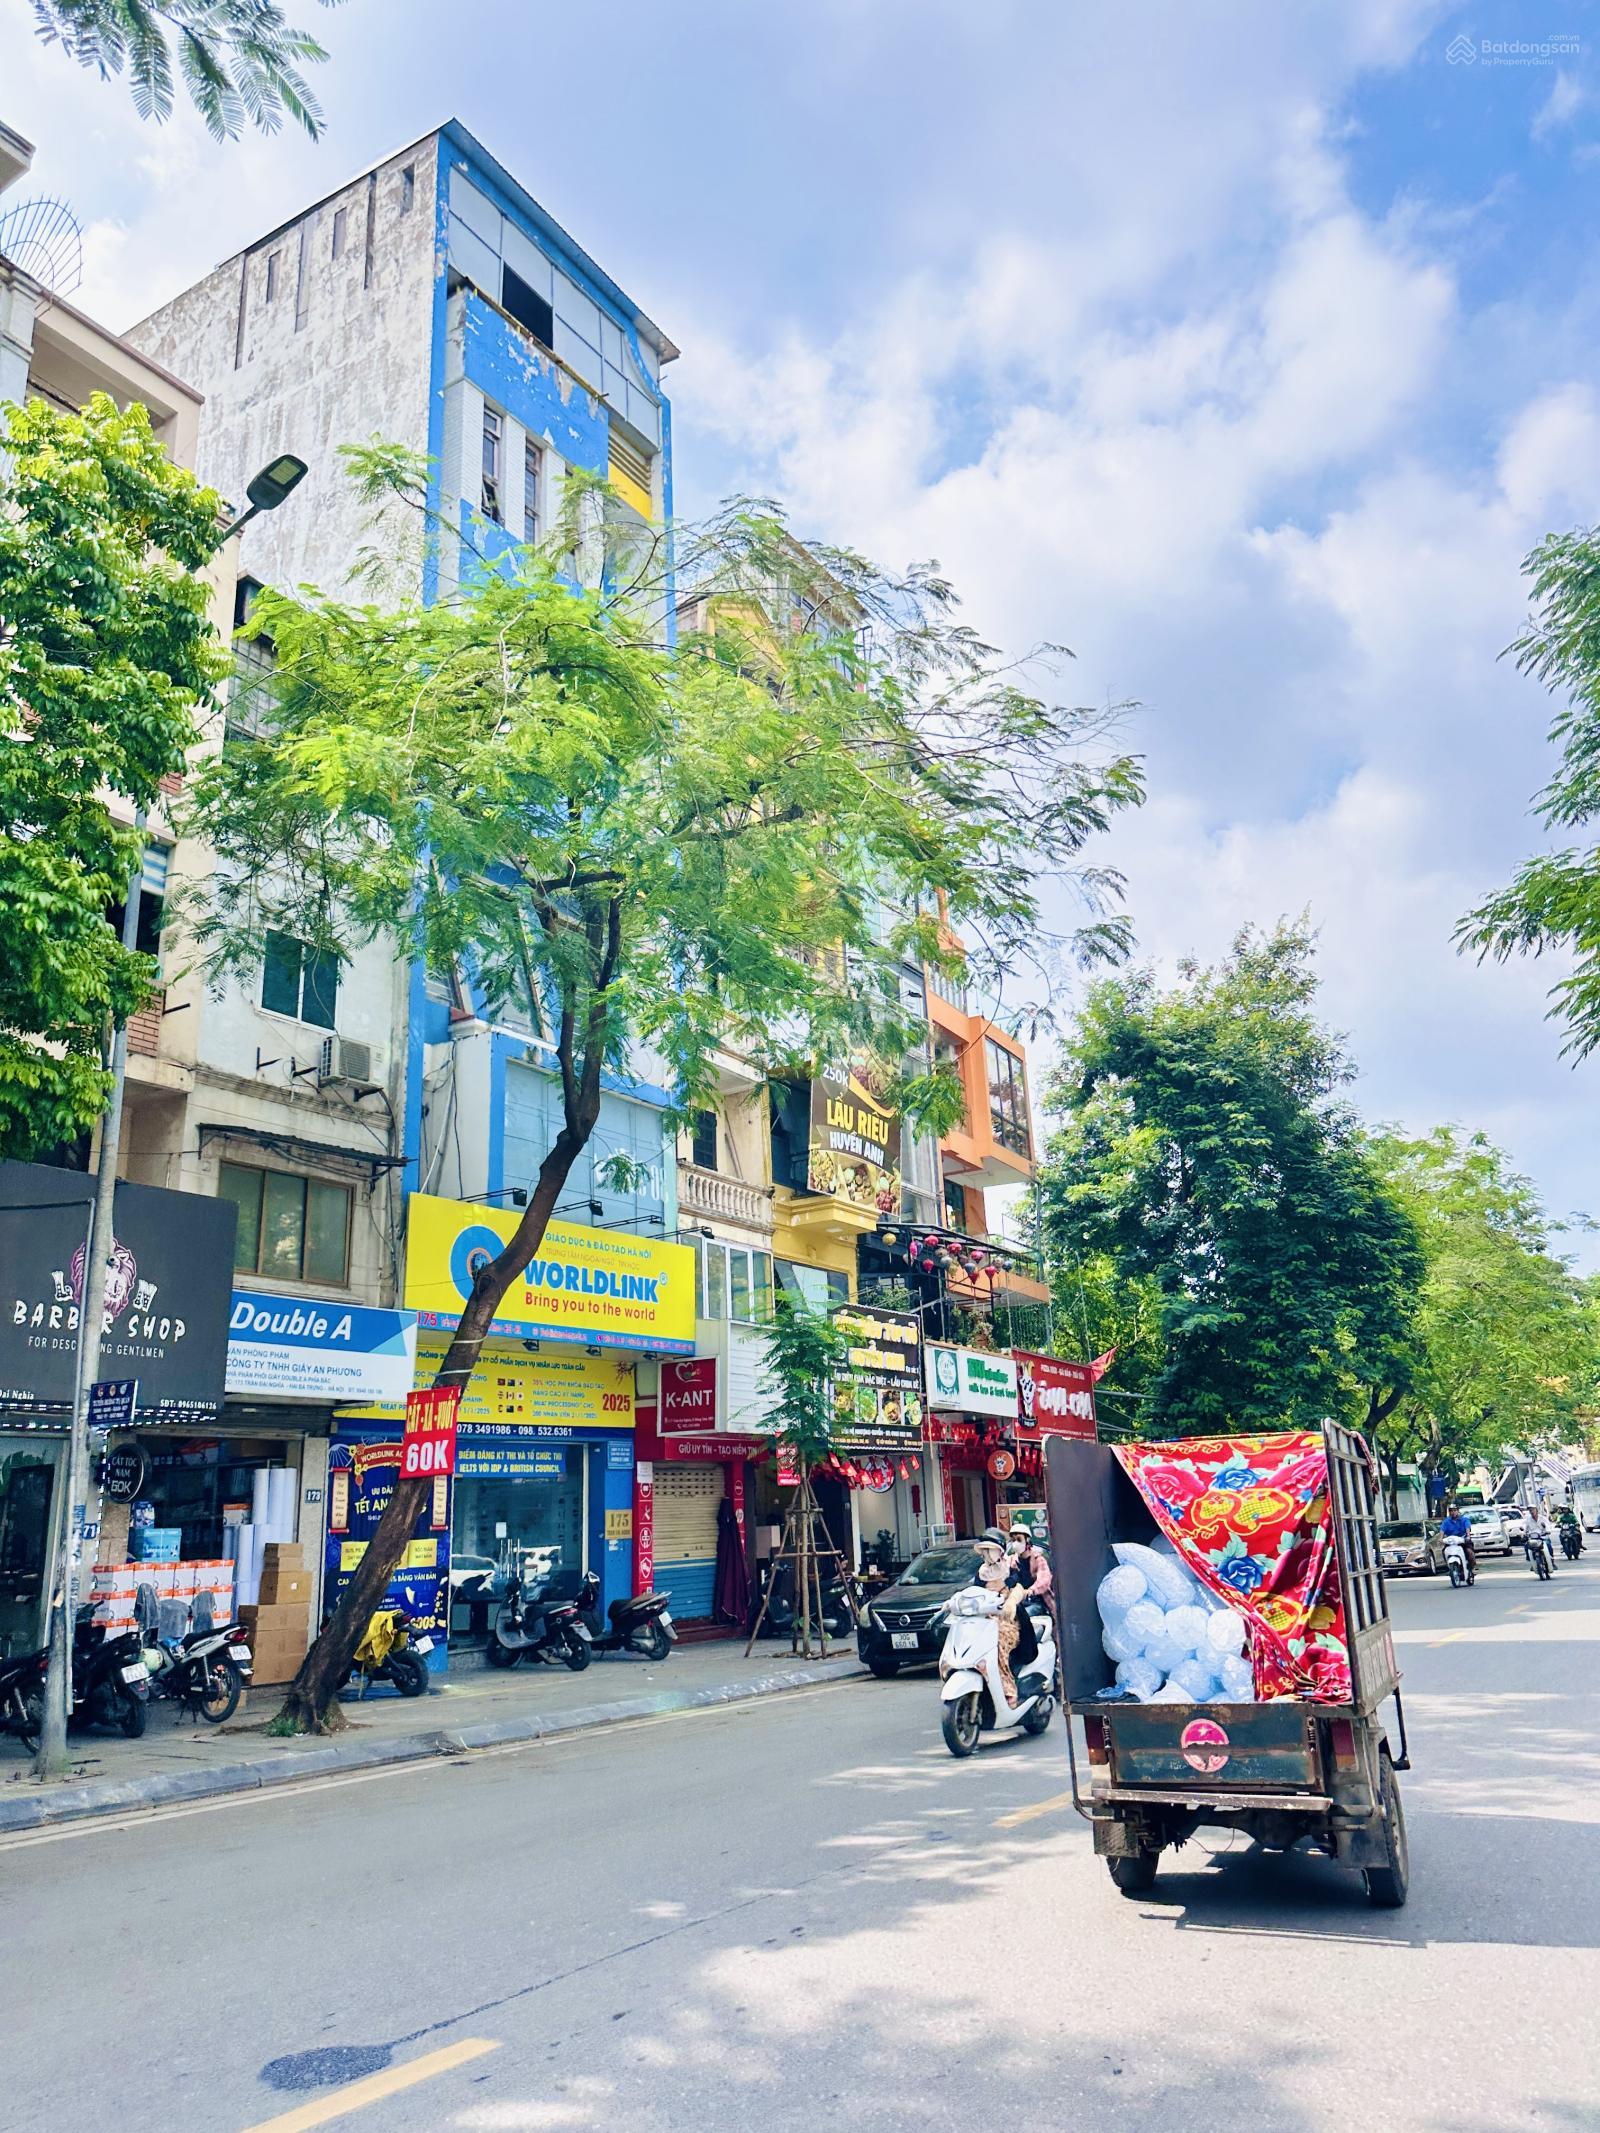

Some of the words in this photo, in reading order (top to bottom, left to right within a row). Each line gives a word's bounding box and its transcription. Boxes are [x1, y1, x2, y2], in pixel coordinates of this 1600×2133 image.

[827, 1092, 854, 1131] LẨU
[858, 1111, 889, 1145] RIÊU
[863, 1141, 885, 1166] ANH
[586, 1240, 591, 1248] &
[524, 1259, 659, 1303] WORLDLINK
[525, 1291, 558, 1311] Bring
[562, 1298, 585, 1313] you
[588, 1302, 600, 1314] to
[603, 1303, 621, 1316] the
[624, 1307, 655, 1320] world
[13, 1300, 114, 1335] BARBR
[128, 1314, 186, 1342] SHOP
[229, 1301, 329, 1339] Double
[330, 1314, 352, 1341] A
[416, 1311, 438, 1327] 175
[28, 1336, 48, 1349] FOR
[117, 1345, 164, 1359] GENTLMEN
[254, 1360, 264, 1369] TY
[267, 1361, 290, 1371] TNHH
[313, 1366, 325, 1374] AN
[602, 1393, 630, 1411] 2025
[665, 1389, 713, 1408] K-ANT
[456, 1423, 473, 1434] 078
[475, 1424, 511, 1435] 3491986
[361, 1450, 395, 1462] WORLDLINK
[406, 1440, 449, 1472] 60K
[678, 1442, 691, 1454] GIỮ
[692, 1444, 701, 1454] UY
[702, 1442, 712, 1455] TÍN
[718, 1445, 731, 1457] TẠO
[459, 1463, 477, 1473] IELTS
[503, 1464, 508, 1473] &
[307, 1490, 321, 1501] 173
[354, 1495, 370, 1515] TẾT
[610, 1513, 629, 1527] 175
